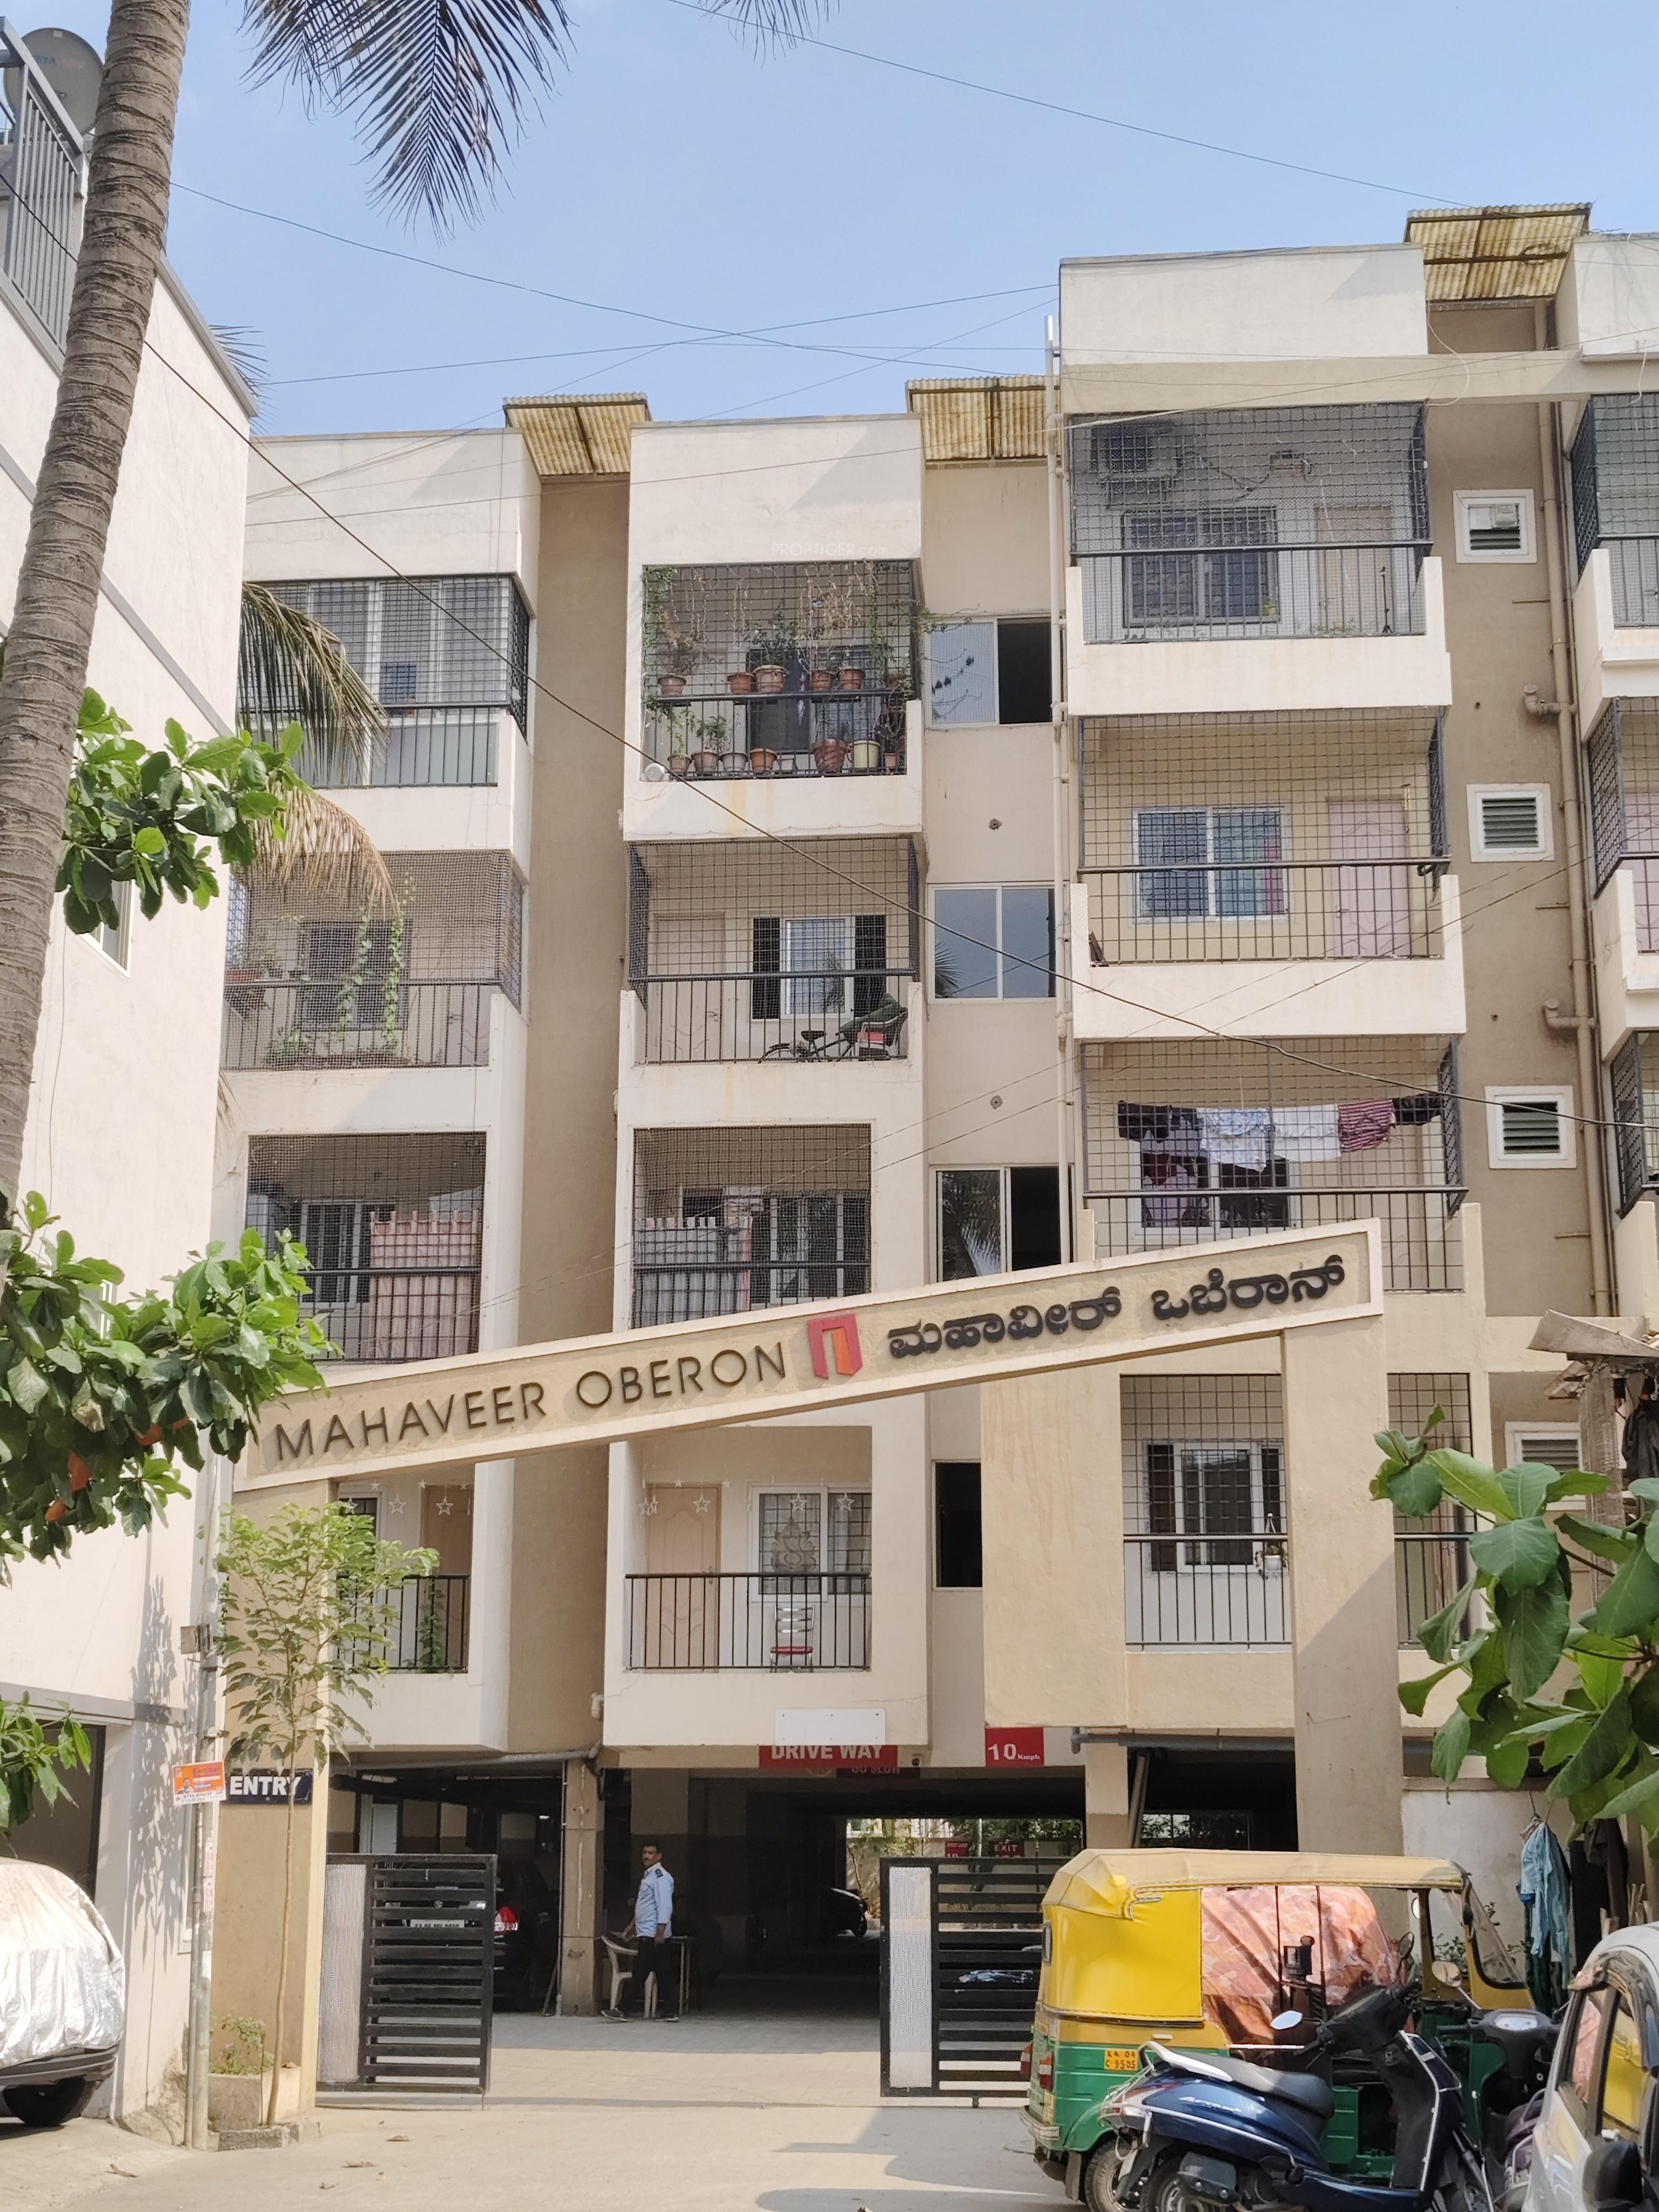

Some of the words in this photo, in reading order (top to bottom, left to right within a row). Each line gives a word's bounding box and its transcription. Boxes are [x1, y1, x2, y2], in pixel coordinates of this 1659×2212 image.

[888, 1286, 1122, 1358] ಮಹಾವೀರ್
[276, 1381, 546, 1460] MAHAVEER
[576, 1342, 786, 1407] OBERON
[771, 1745, 833, 1759] DRIVE
[839, 1745, 883, 1759] WAY
[988, 1743, 1016, 1761] 10
[230, 1776, 302, 1796] ENTRY
[994, 1844, 1017, 1852] EXIT
